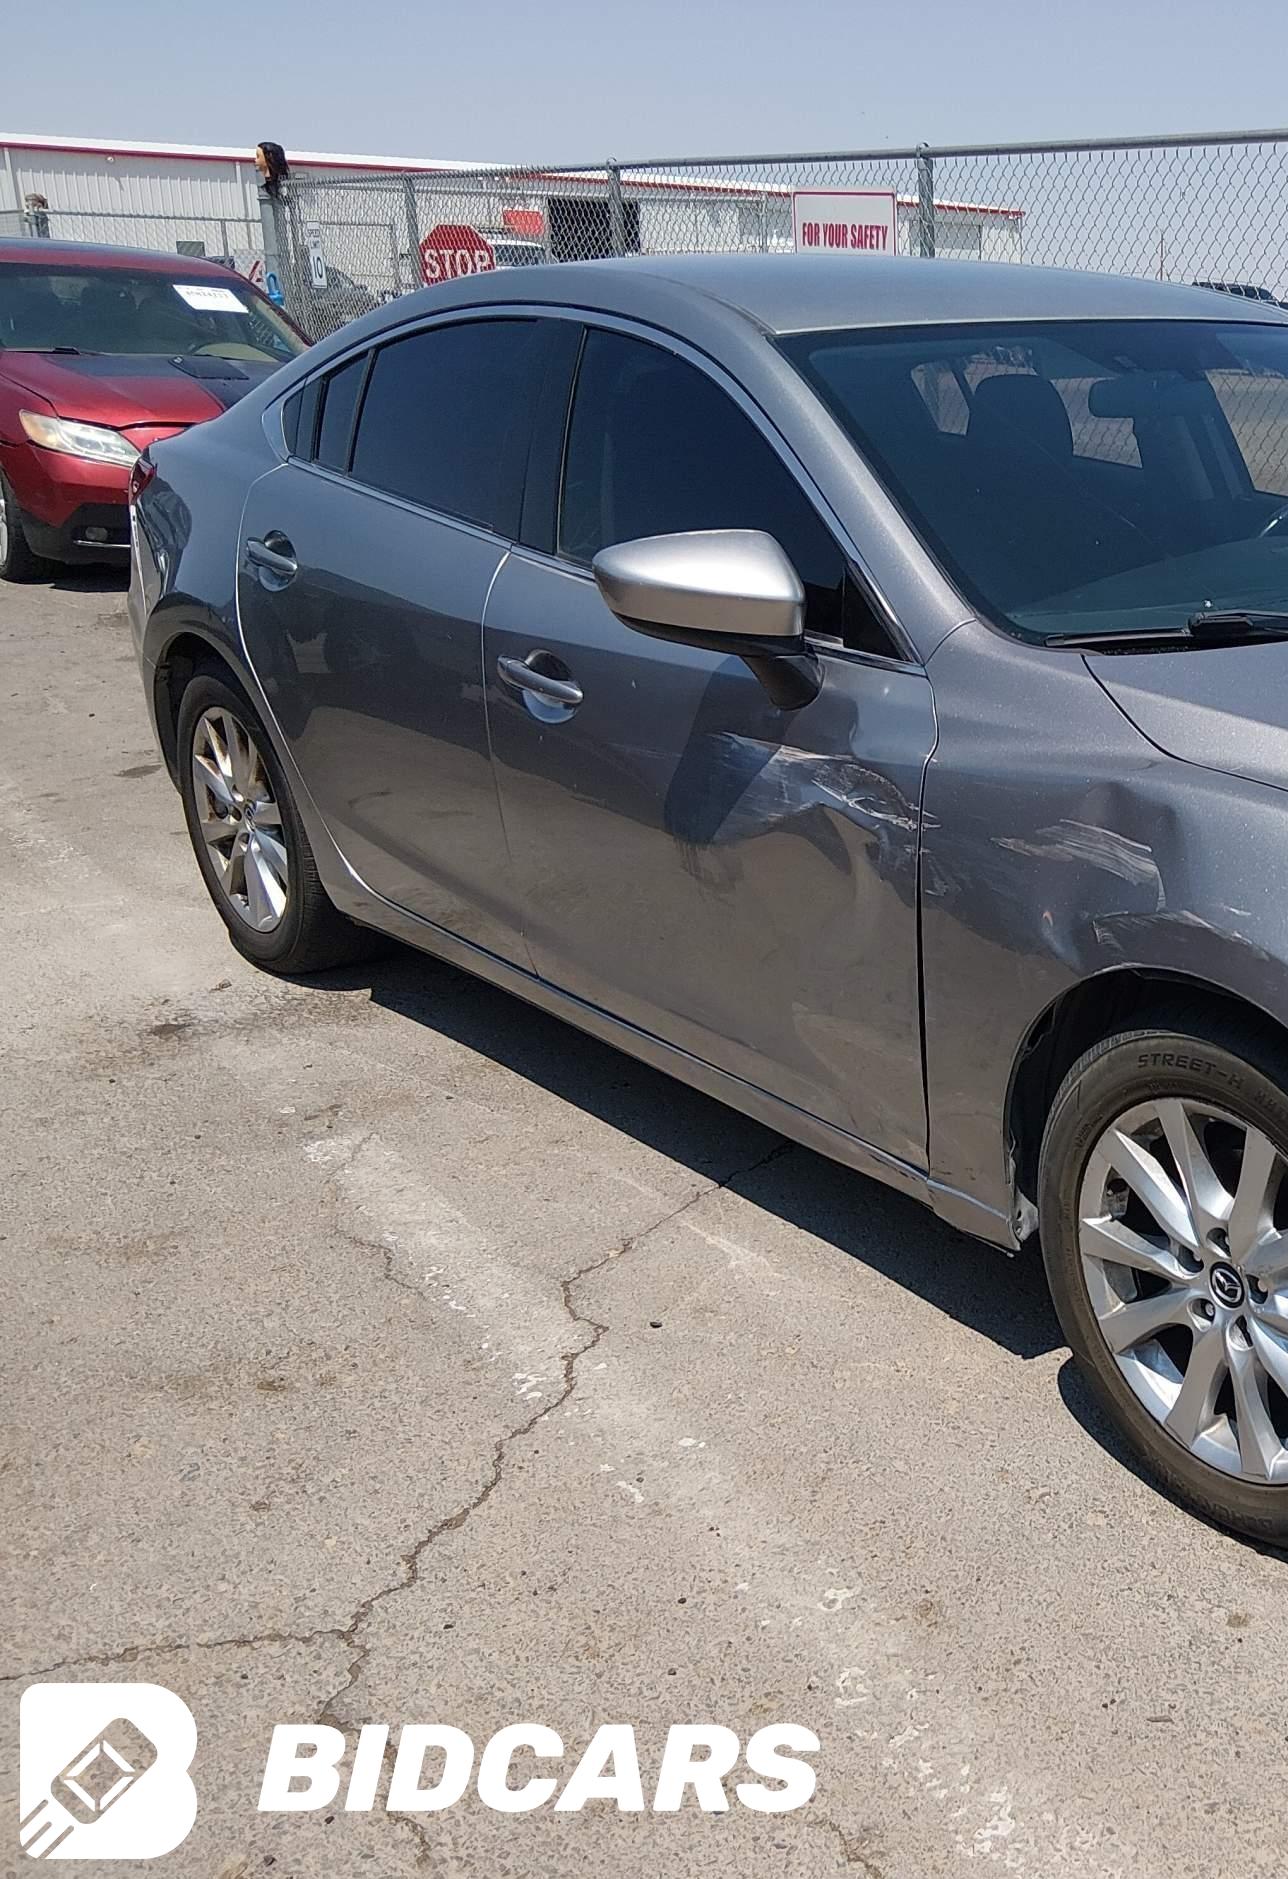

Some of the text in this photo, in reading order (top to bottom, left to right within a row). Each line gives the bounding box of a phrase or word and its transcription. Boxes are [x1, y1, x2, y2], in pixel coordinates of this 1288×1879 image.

[802, 222, 888, 251] FOR YOUR SAFETY
[312, 256, 323, 278] 10
[424, 248, 492, 279] STOP
